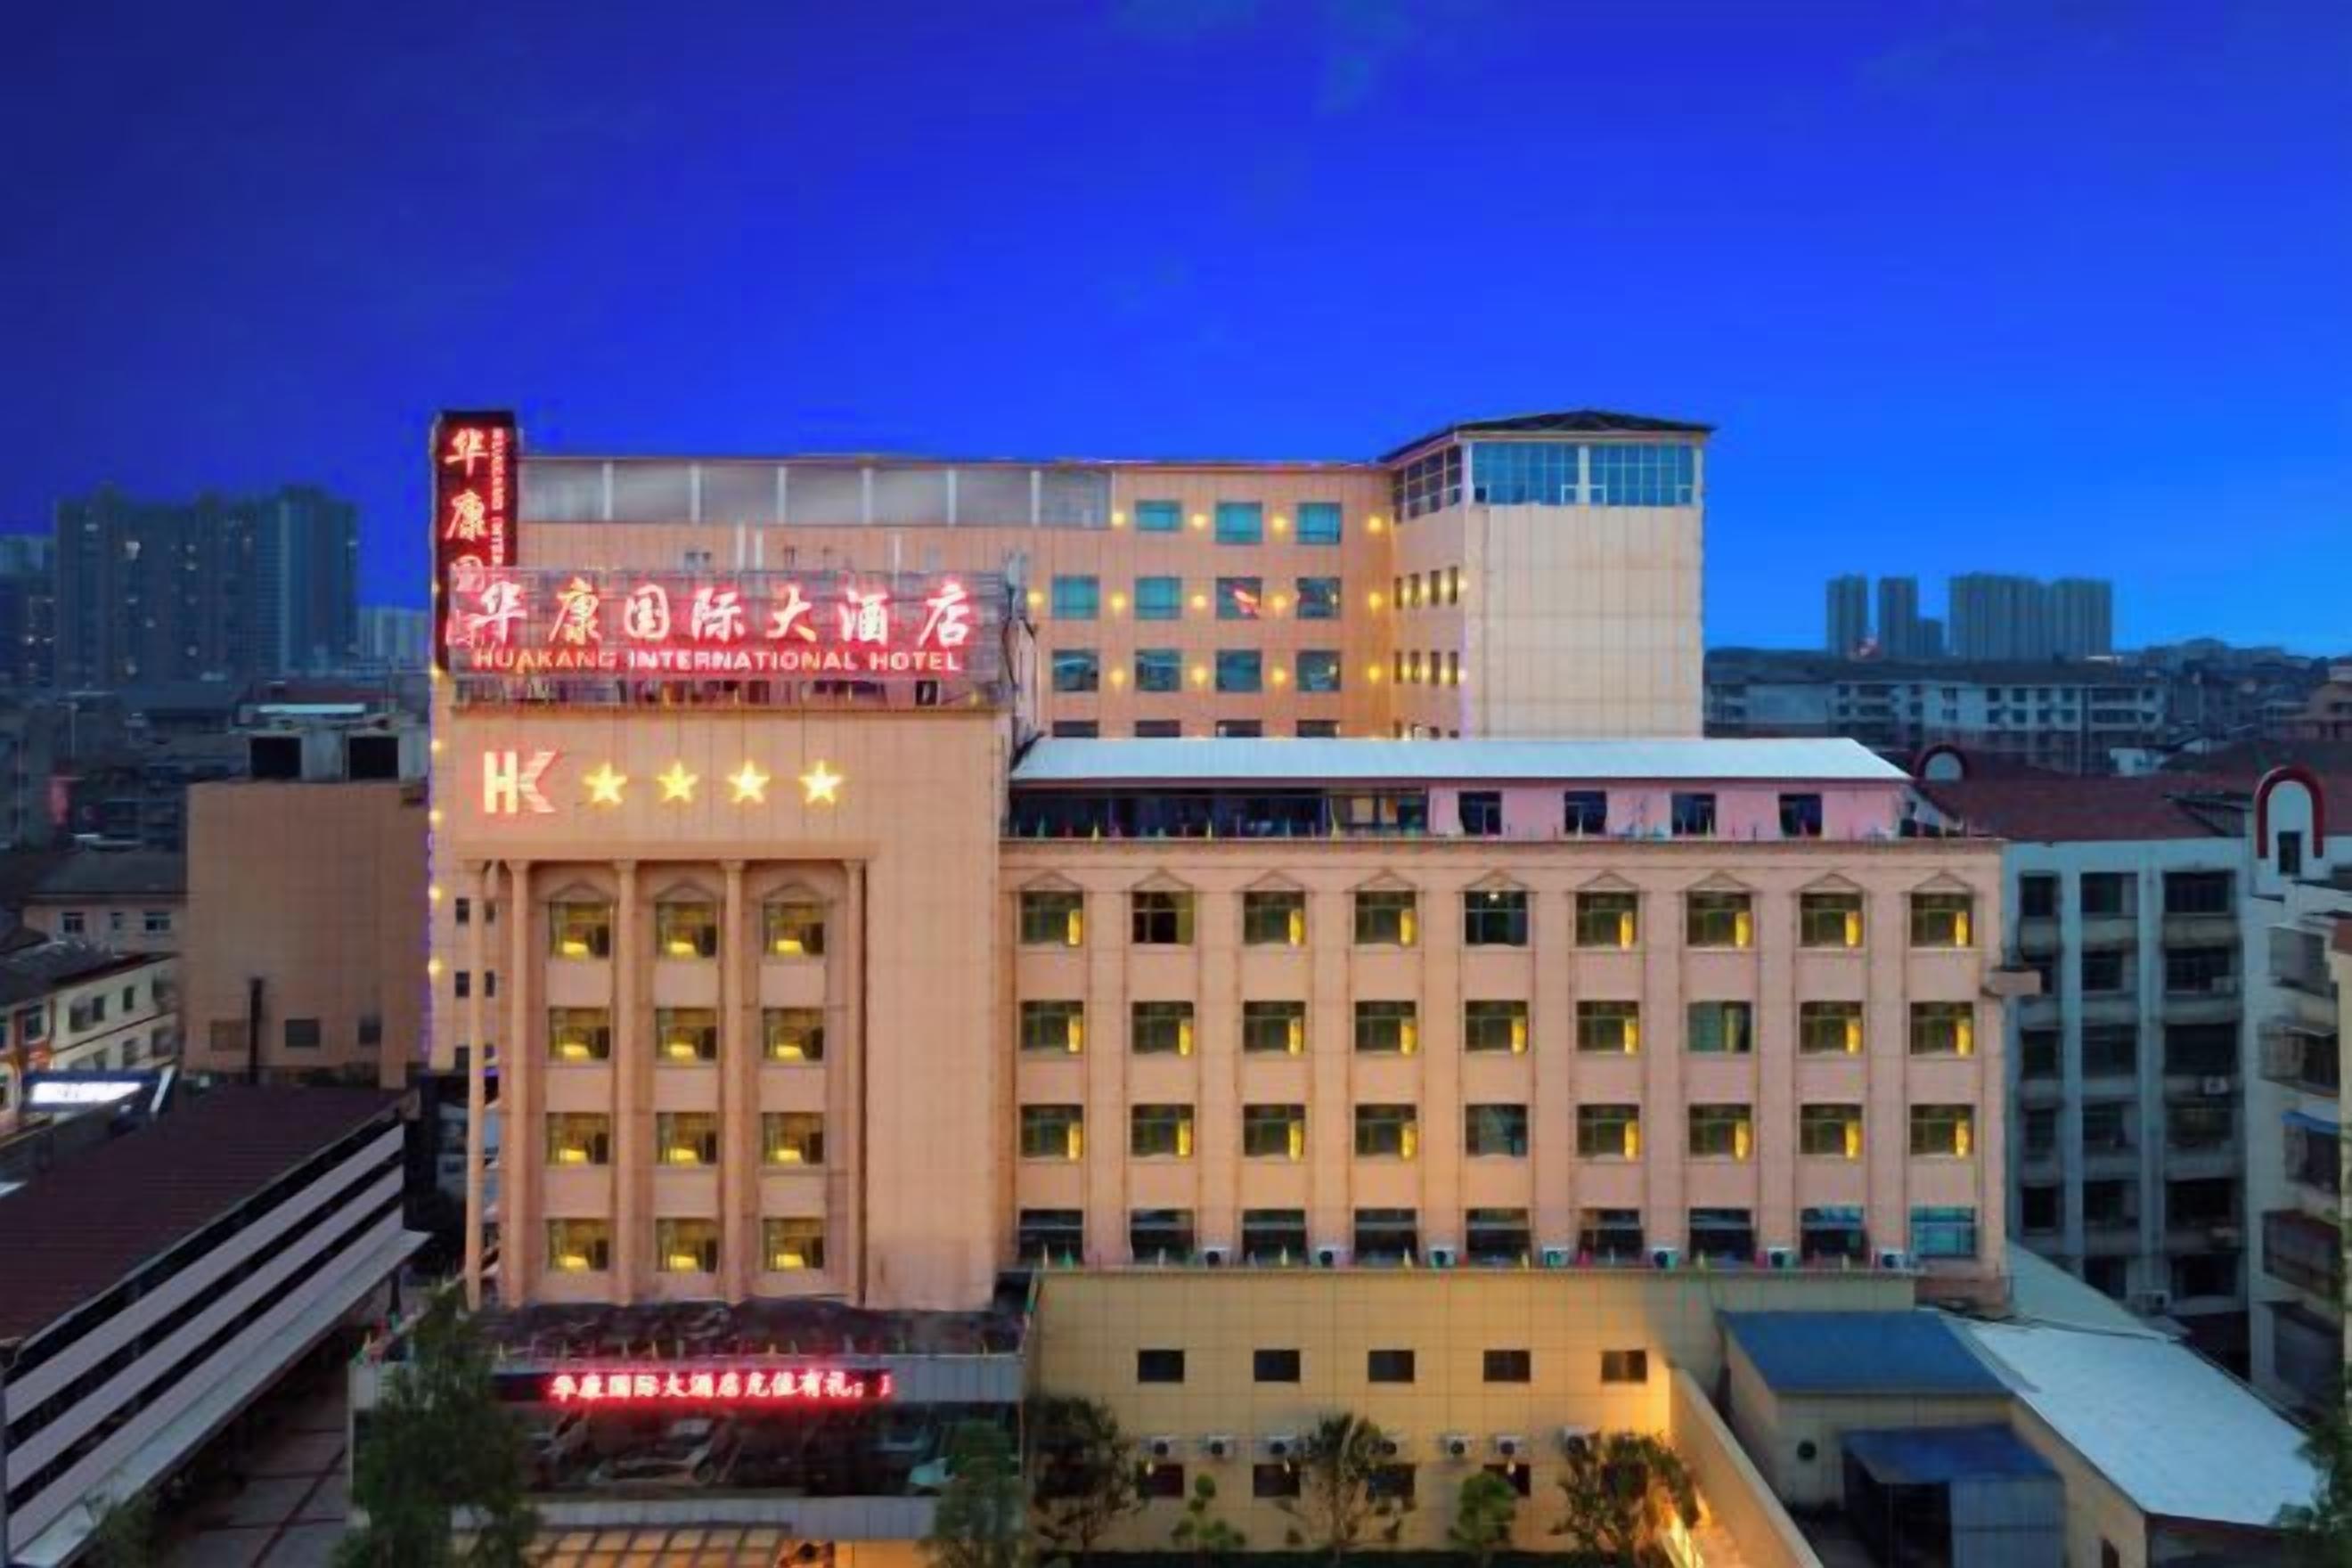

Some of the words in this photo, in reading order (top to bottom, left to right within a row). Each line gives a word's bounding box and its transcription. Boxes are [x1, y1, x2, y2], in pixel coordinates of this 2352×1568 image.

[469, 579, 971, 647] 华康国际大酒店
[473, 650, 617, 669] HUAKANG
[628, 650, 857, 670] INTERNATIONAL
[870, 651, 961, 670] HOTEL
[484, 751, 556, 813] HK
